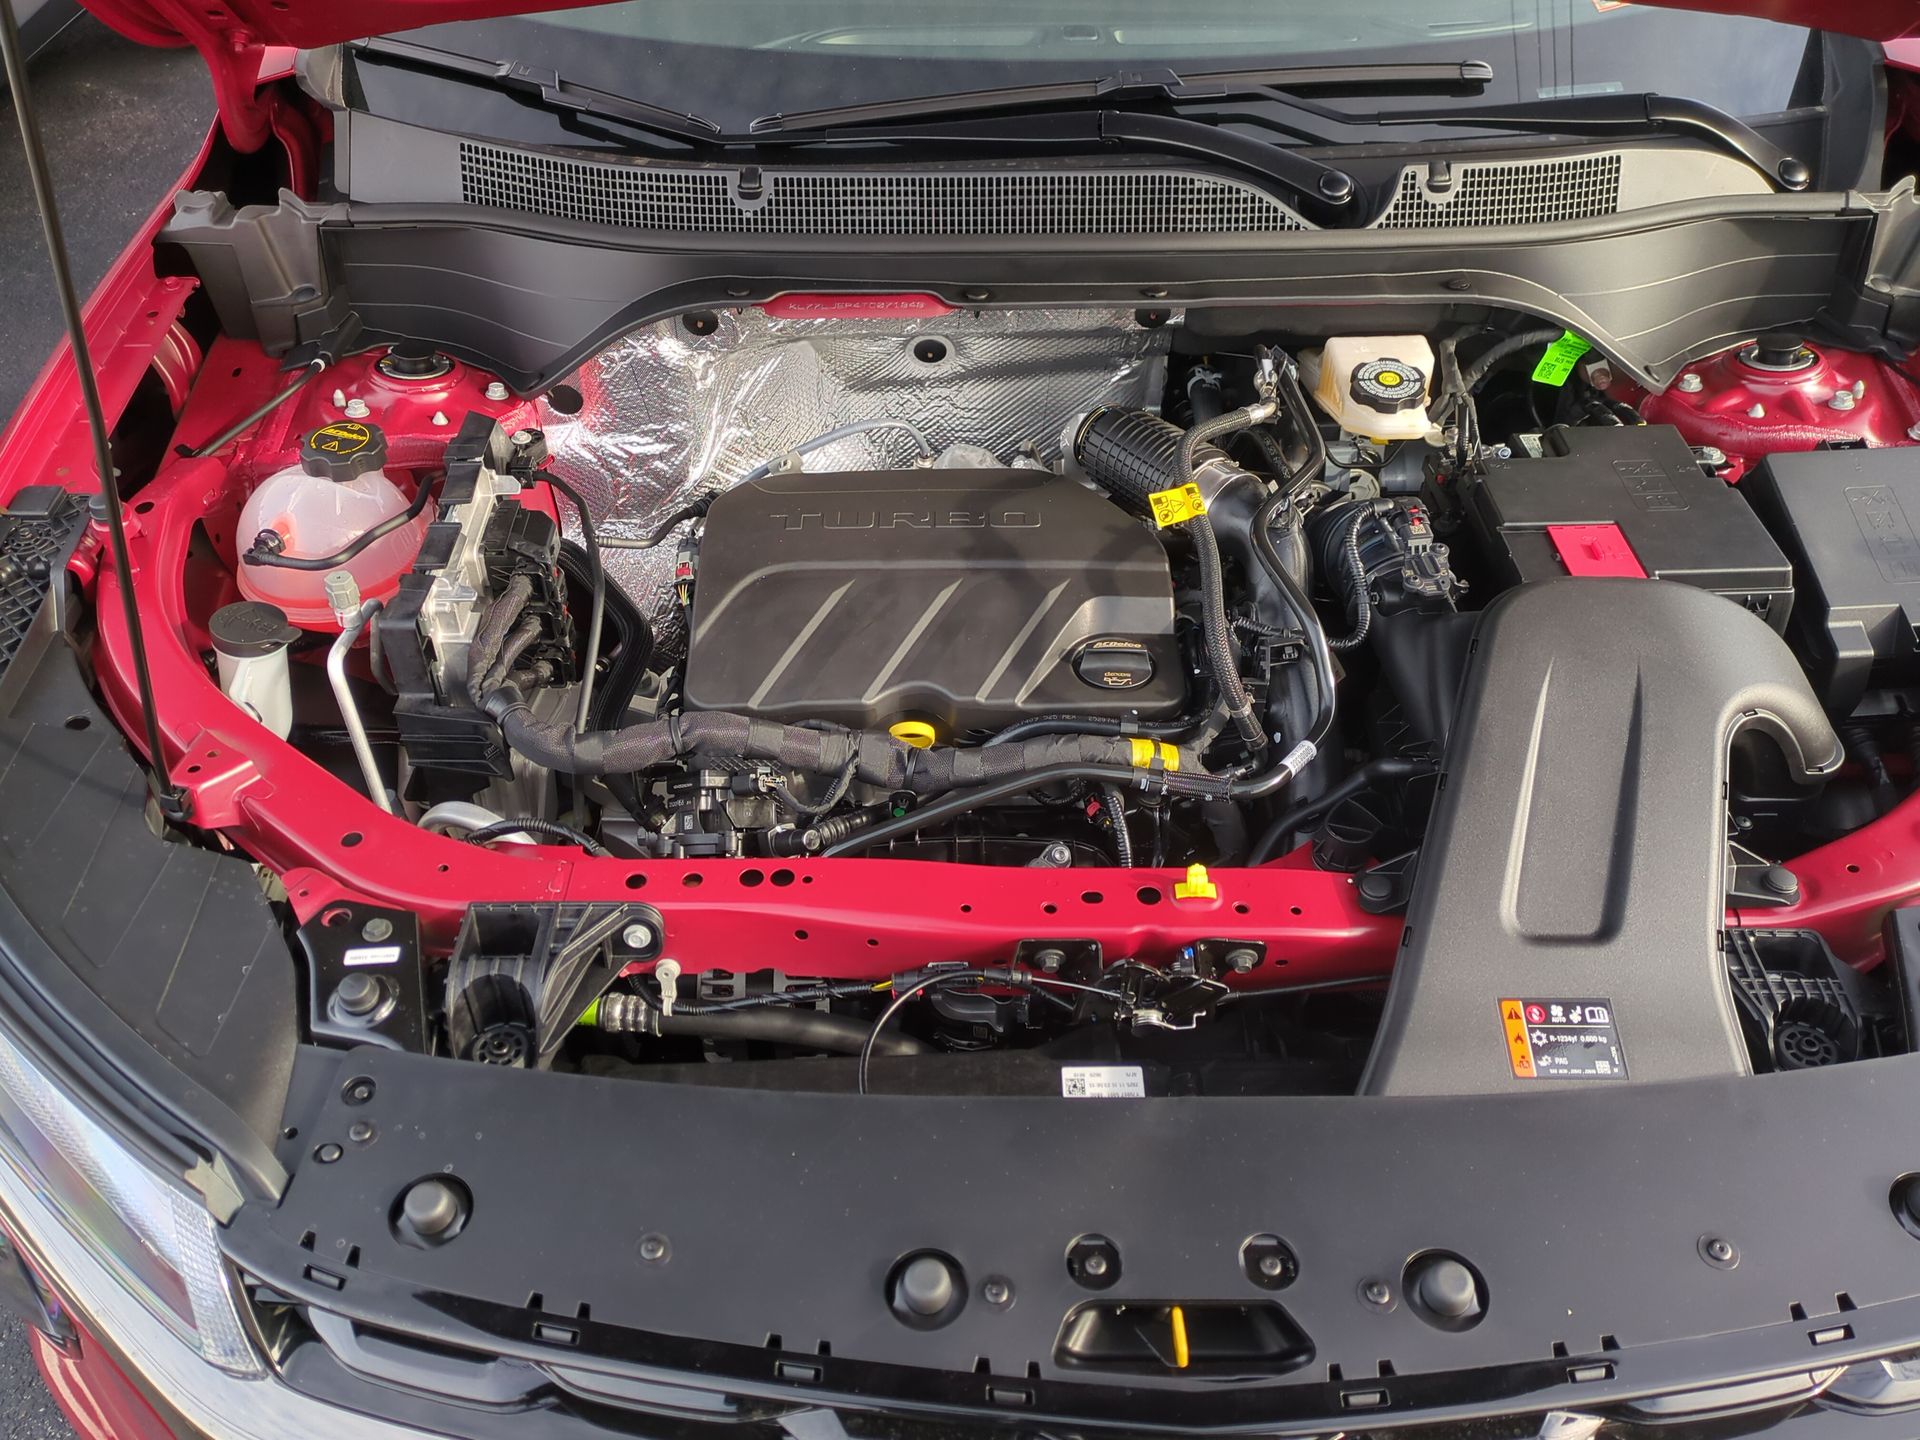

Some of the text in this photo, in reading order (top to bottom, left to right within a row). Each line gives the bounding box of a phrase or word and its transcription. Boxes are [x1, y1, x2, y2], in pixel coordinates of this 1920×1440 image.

[769, 511, 1042, 530] TURBO
[1550, 1035, 1577, 1043] R-1234yf
[1598, 1035, 1607, 1044] kg
